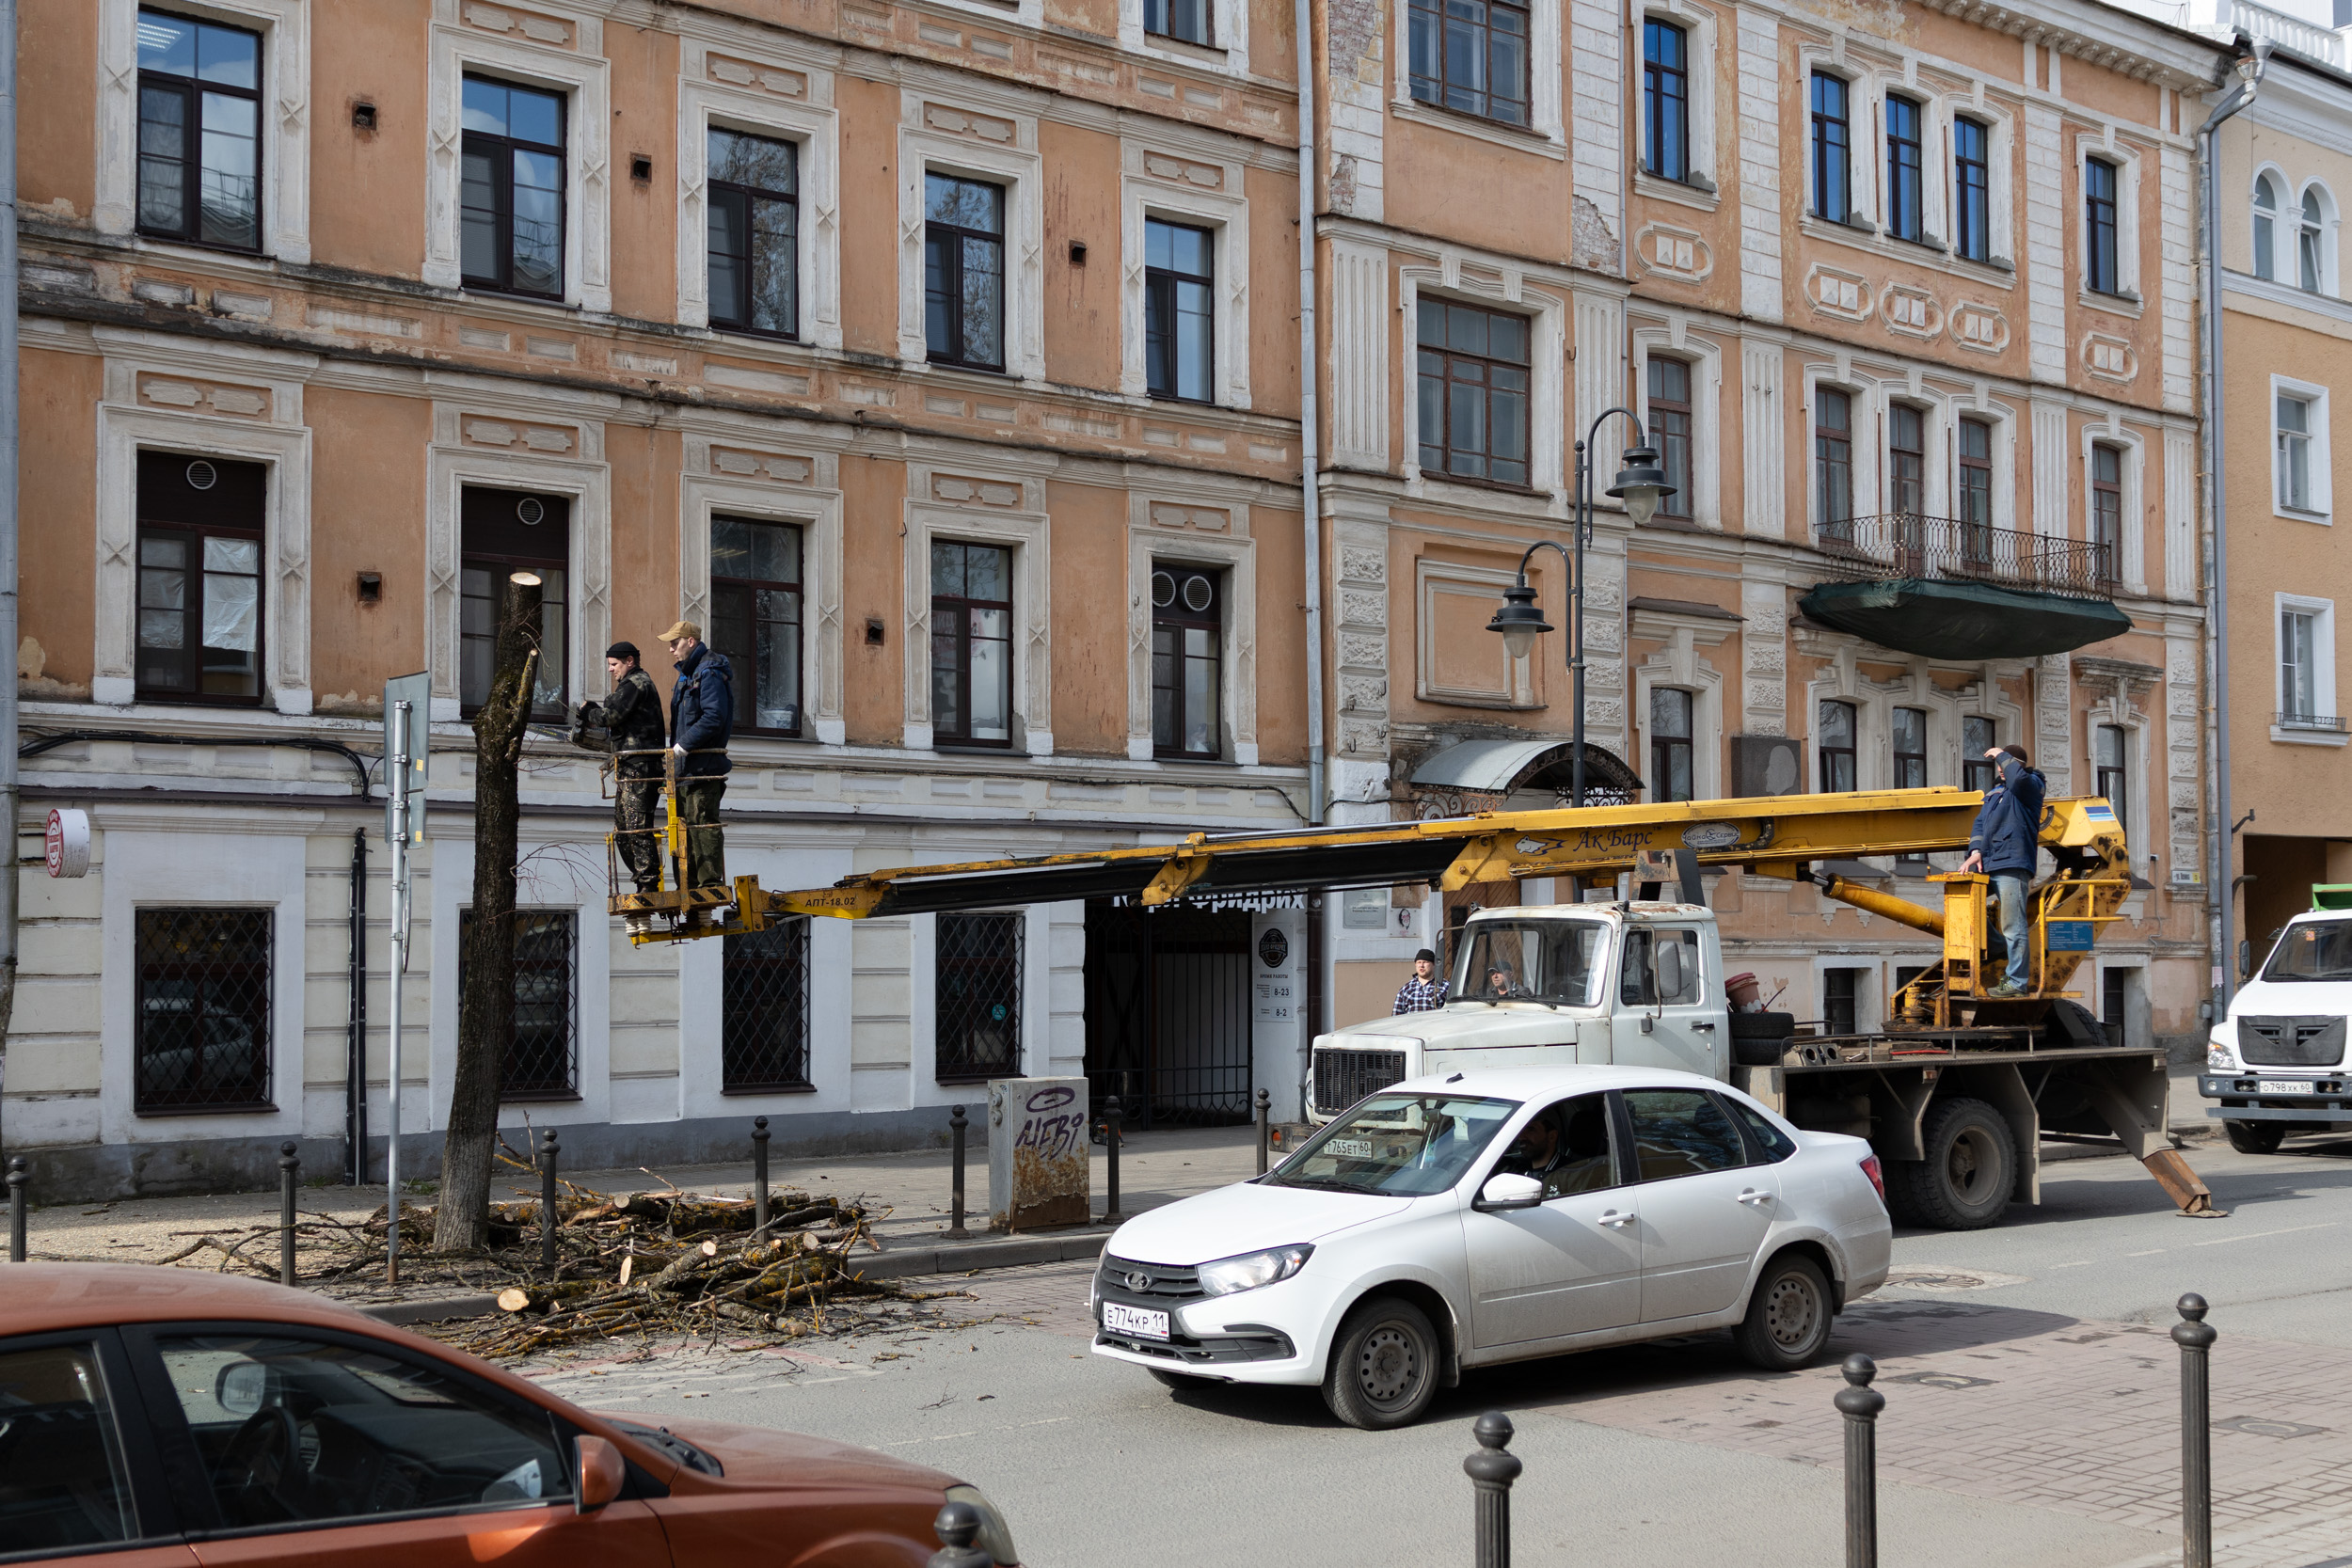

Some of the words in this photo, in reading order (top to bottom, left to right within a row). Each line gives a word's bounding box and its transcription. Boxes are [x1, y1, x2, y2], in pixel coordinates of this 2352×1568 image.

[1572, 831, 1608, 852] Ак
[1608, 829, 1653, 852] Барс
[805, 897, 855, 907] АПТ-18.02
[1276, 1008, 1287, 1017] 8-2
[1153, 1313, 1164, 1327] 11
